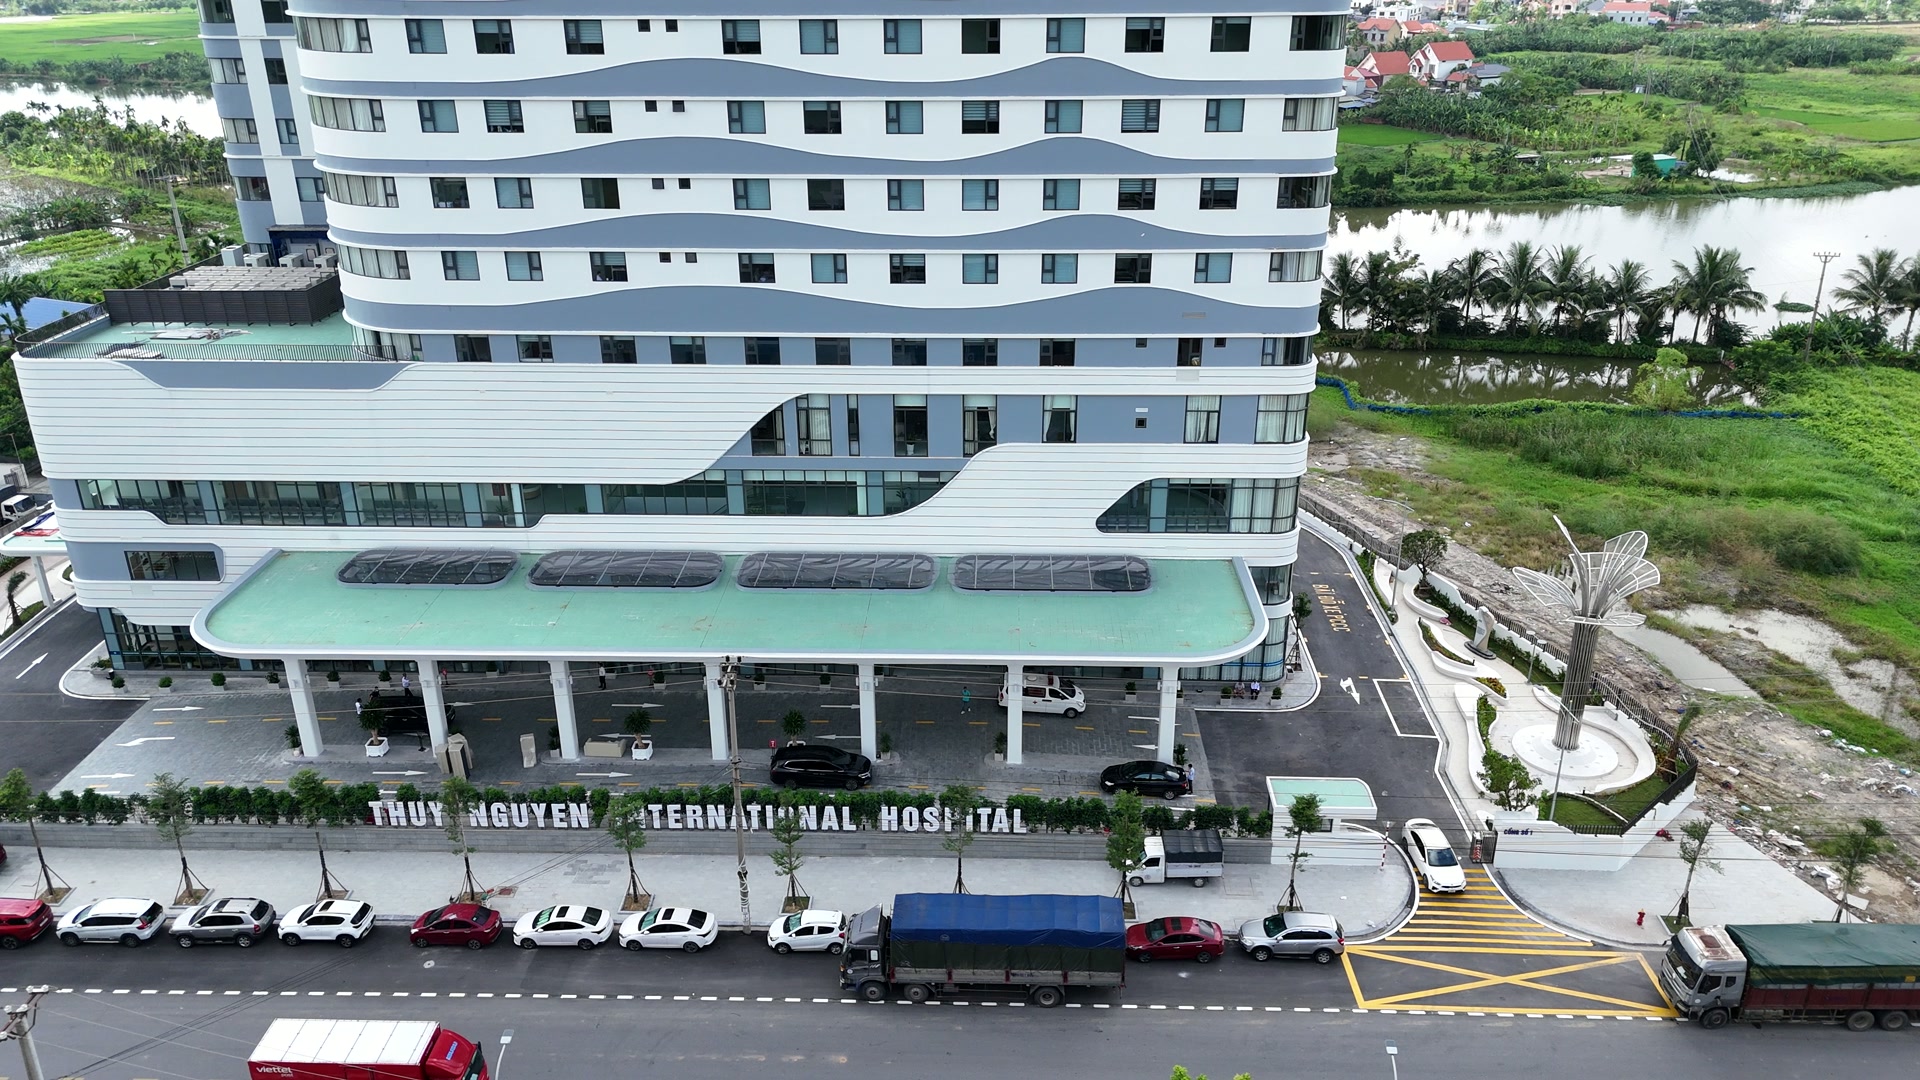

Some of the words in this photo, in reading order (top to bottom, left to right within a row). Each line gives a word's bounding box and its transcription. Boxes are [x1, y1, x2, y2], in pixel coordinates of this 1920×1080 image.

[368, 801, 443, 827] THUY
[467, 802, 590, 829] NGUYEN
[614, 804, 857, 831] TERNATINAL
[256, 1066, 293, 1074] viettel
